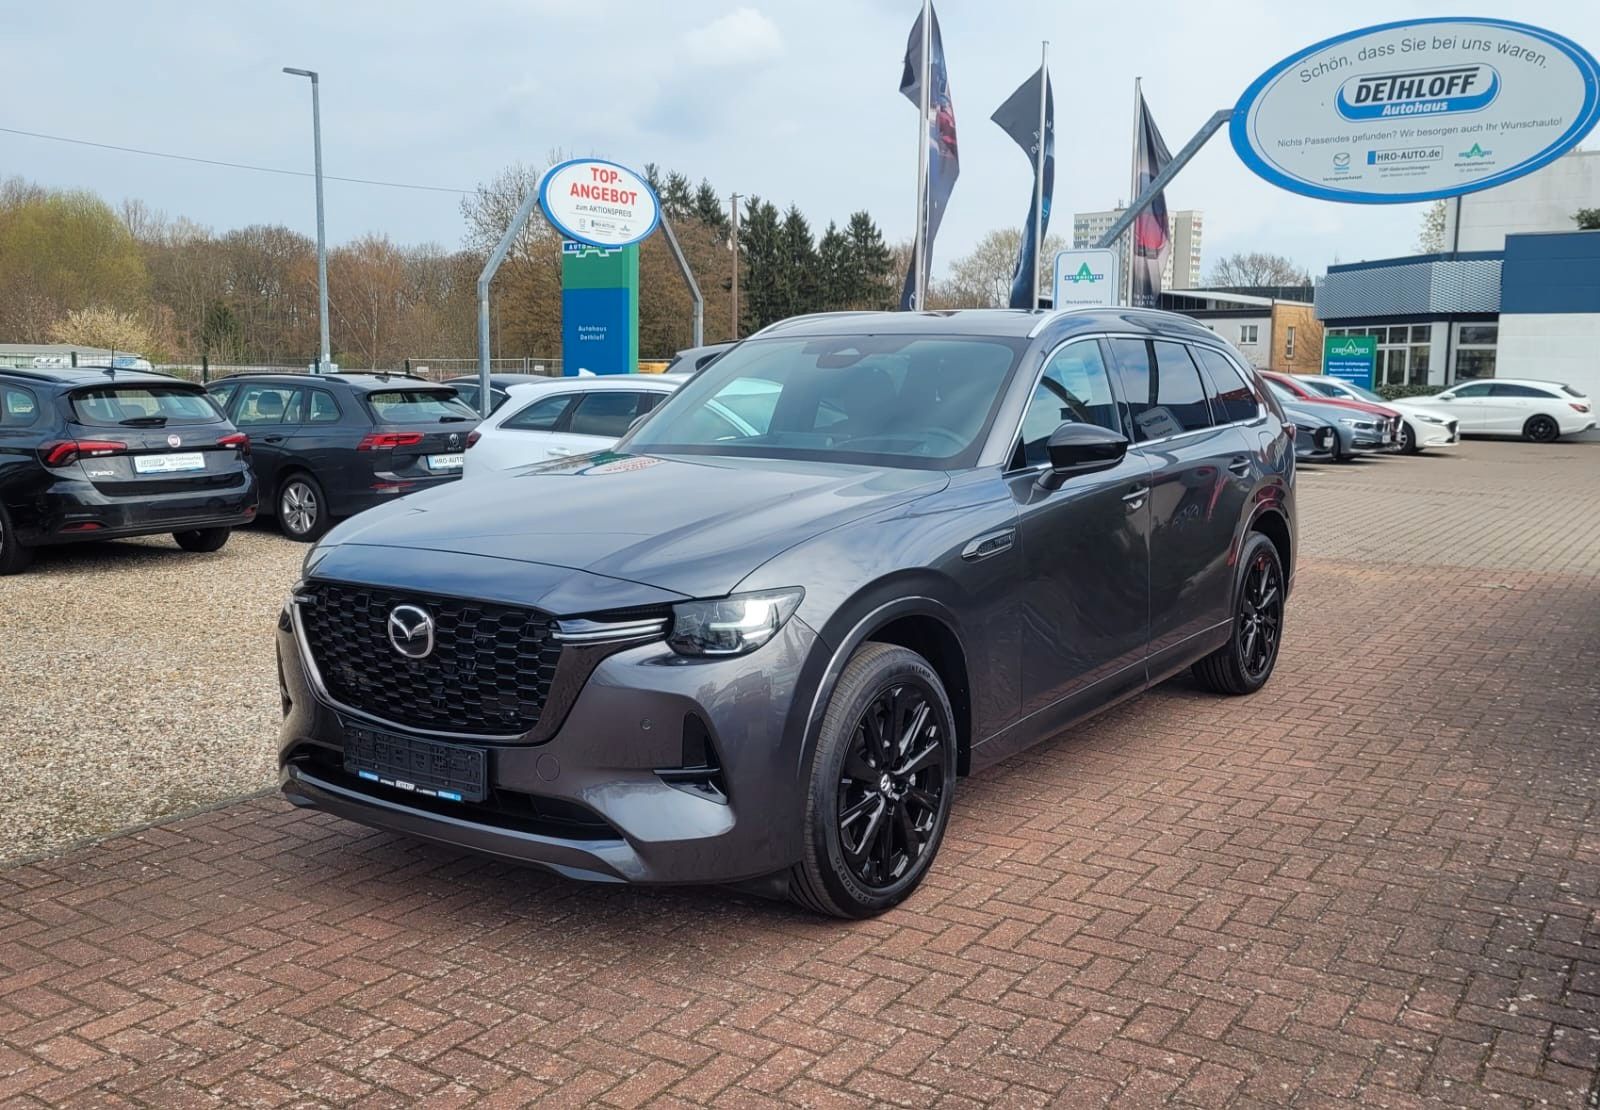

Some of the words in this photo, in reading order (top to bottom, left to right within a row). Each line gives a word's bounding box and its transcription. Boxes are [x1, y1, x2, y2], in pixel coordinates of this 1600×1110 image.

[1299, 55, 1353, 83] Schön,
[1358, 44, 1395, 61] dass
[1400, 38, 1426, 53] Sie
[1432, 35, 1457, 50] bei
[1461, 39, 1492, 52] uns
[1497, 41, 1547, 69] waren.
[1355, 67, 1480, 104] DETHLOFF
[1382, 100, 1448, 116] Autohaus
[1277, 139, 1302, 148] Nichts
[1305, 135, 1350, 146] Passendes
[1352, 130, 1398, 144] gefunden?
[1399, 128, 1414, 138] Wir
[1416, 126, 1458, 138] besorgen
[1461, 124, 1483, 134] auch
[1486, 122, 1498, 132] Ihr
[1500, 117, 1562, 130] Wunschauto!
[1377, 149, 1440, 161] HRO-AUTO.de
[590, 167, 623, 184] TOP-
[570, 182, 637, 206] ANGEBOT
[576, 204, 588, 212] zum
[589, 205, 632, 218] AKTIONSPREIS
